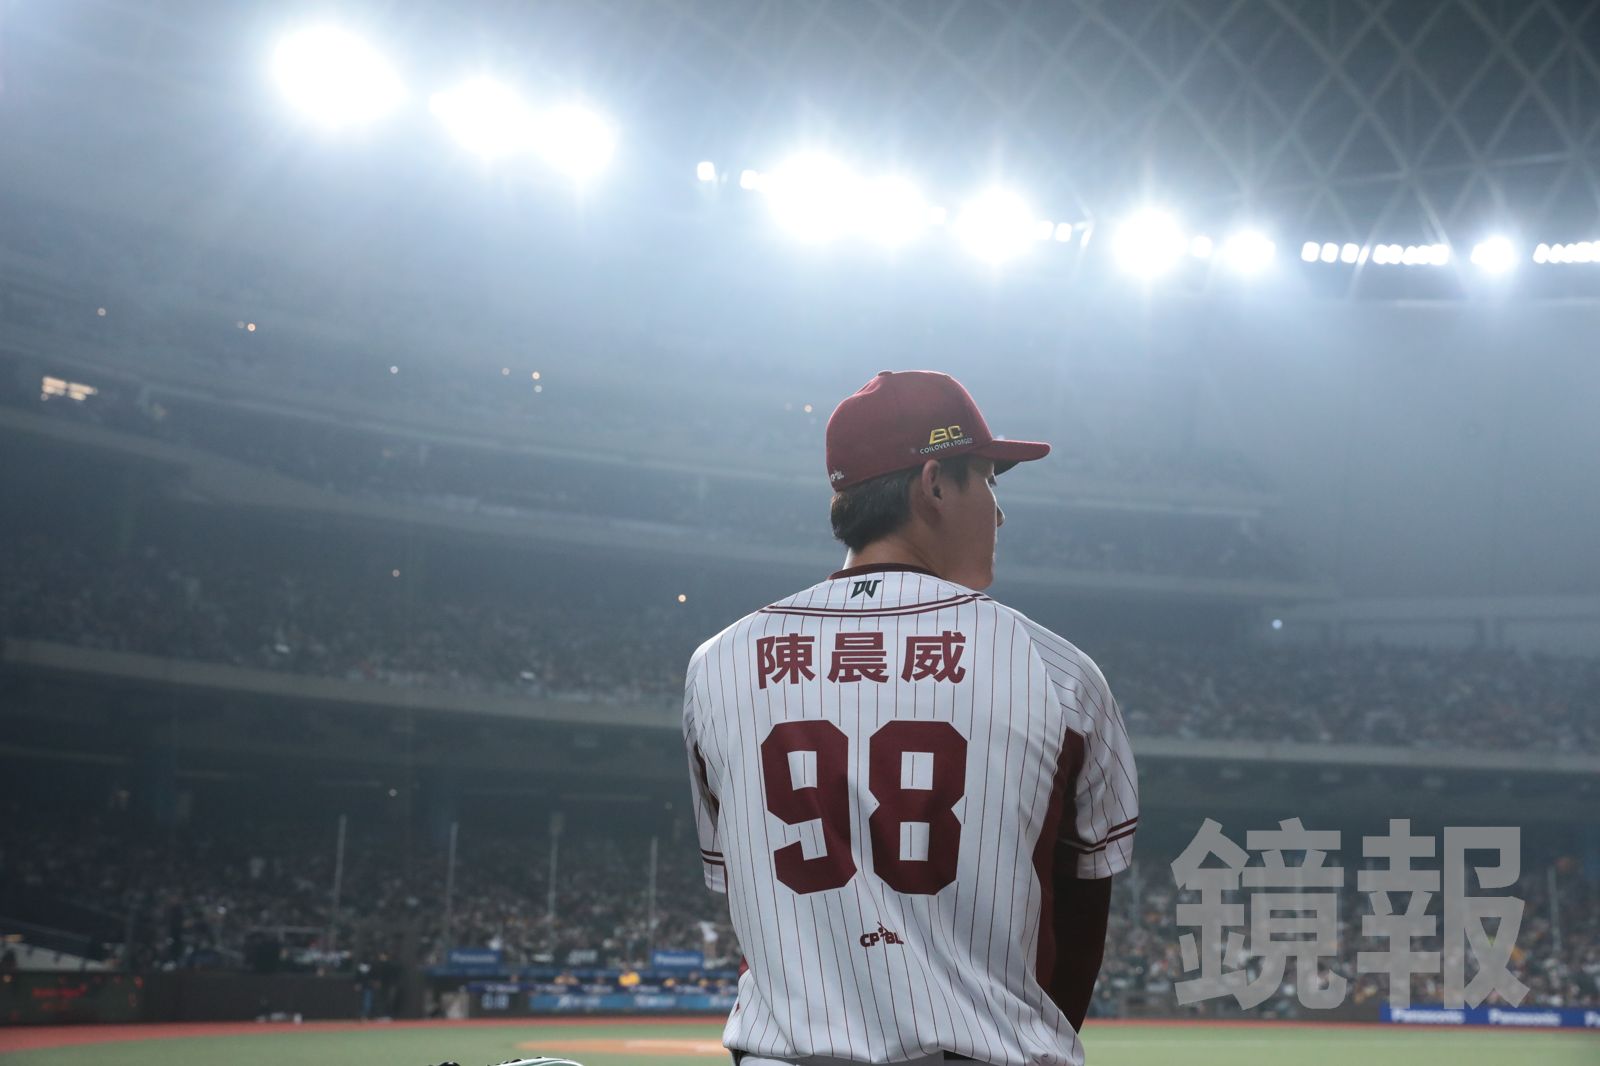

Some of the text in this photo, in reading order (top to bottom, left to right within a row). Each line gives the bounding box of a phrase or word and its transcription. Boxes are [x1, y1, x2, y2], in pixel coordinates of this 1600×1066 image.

[929, 425, 963, 445] BC
[920, 441, 950, 455] COILOVER
[756, 631, 967, 689] 陳晨威
[760, 719, 968, 895] 98
[860, 931, 904, 947] CPBL
